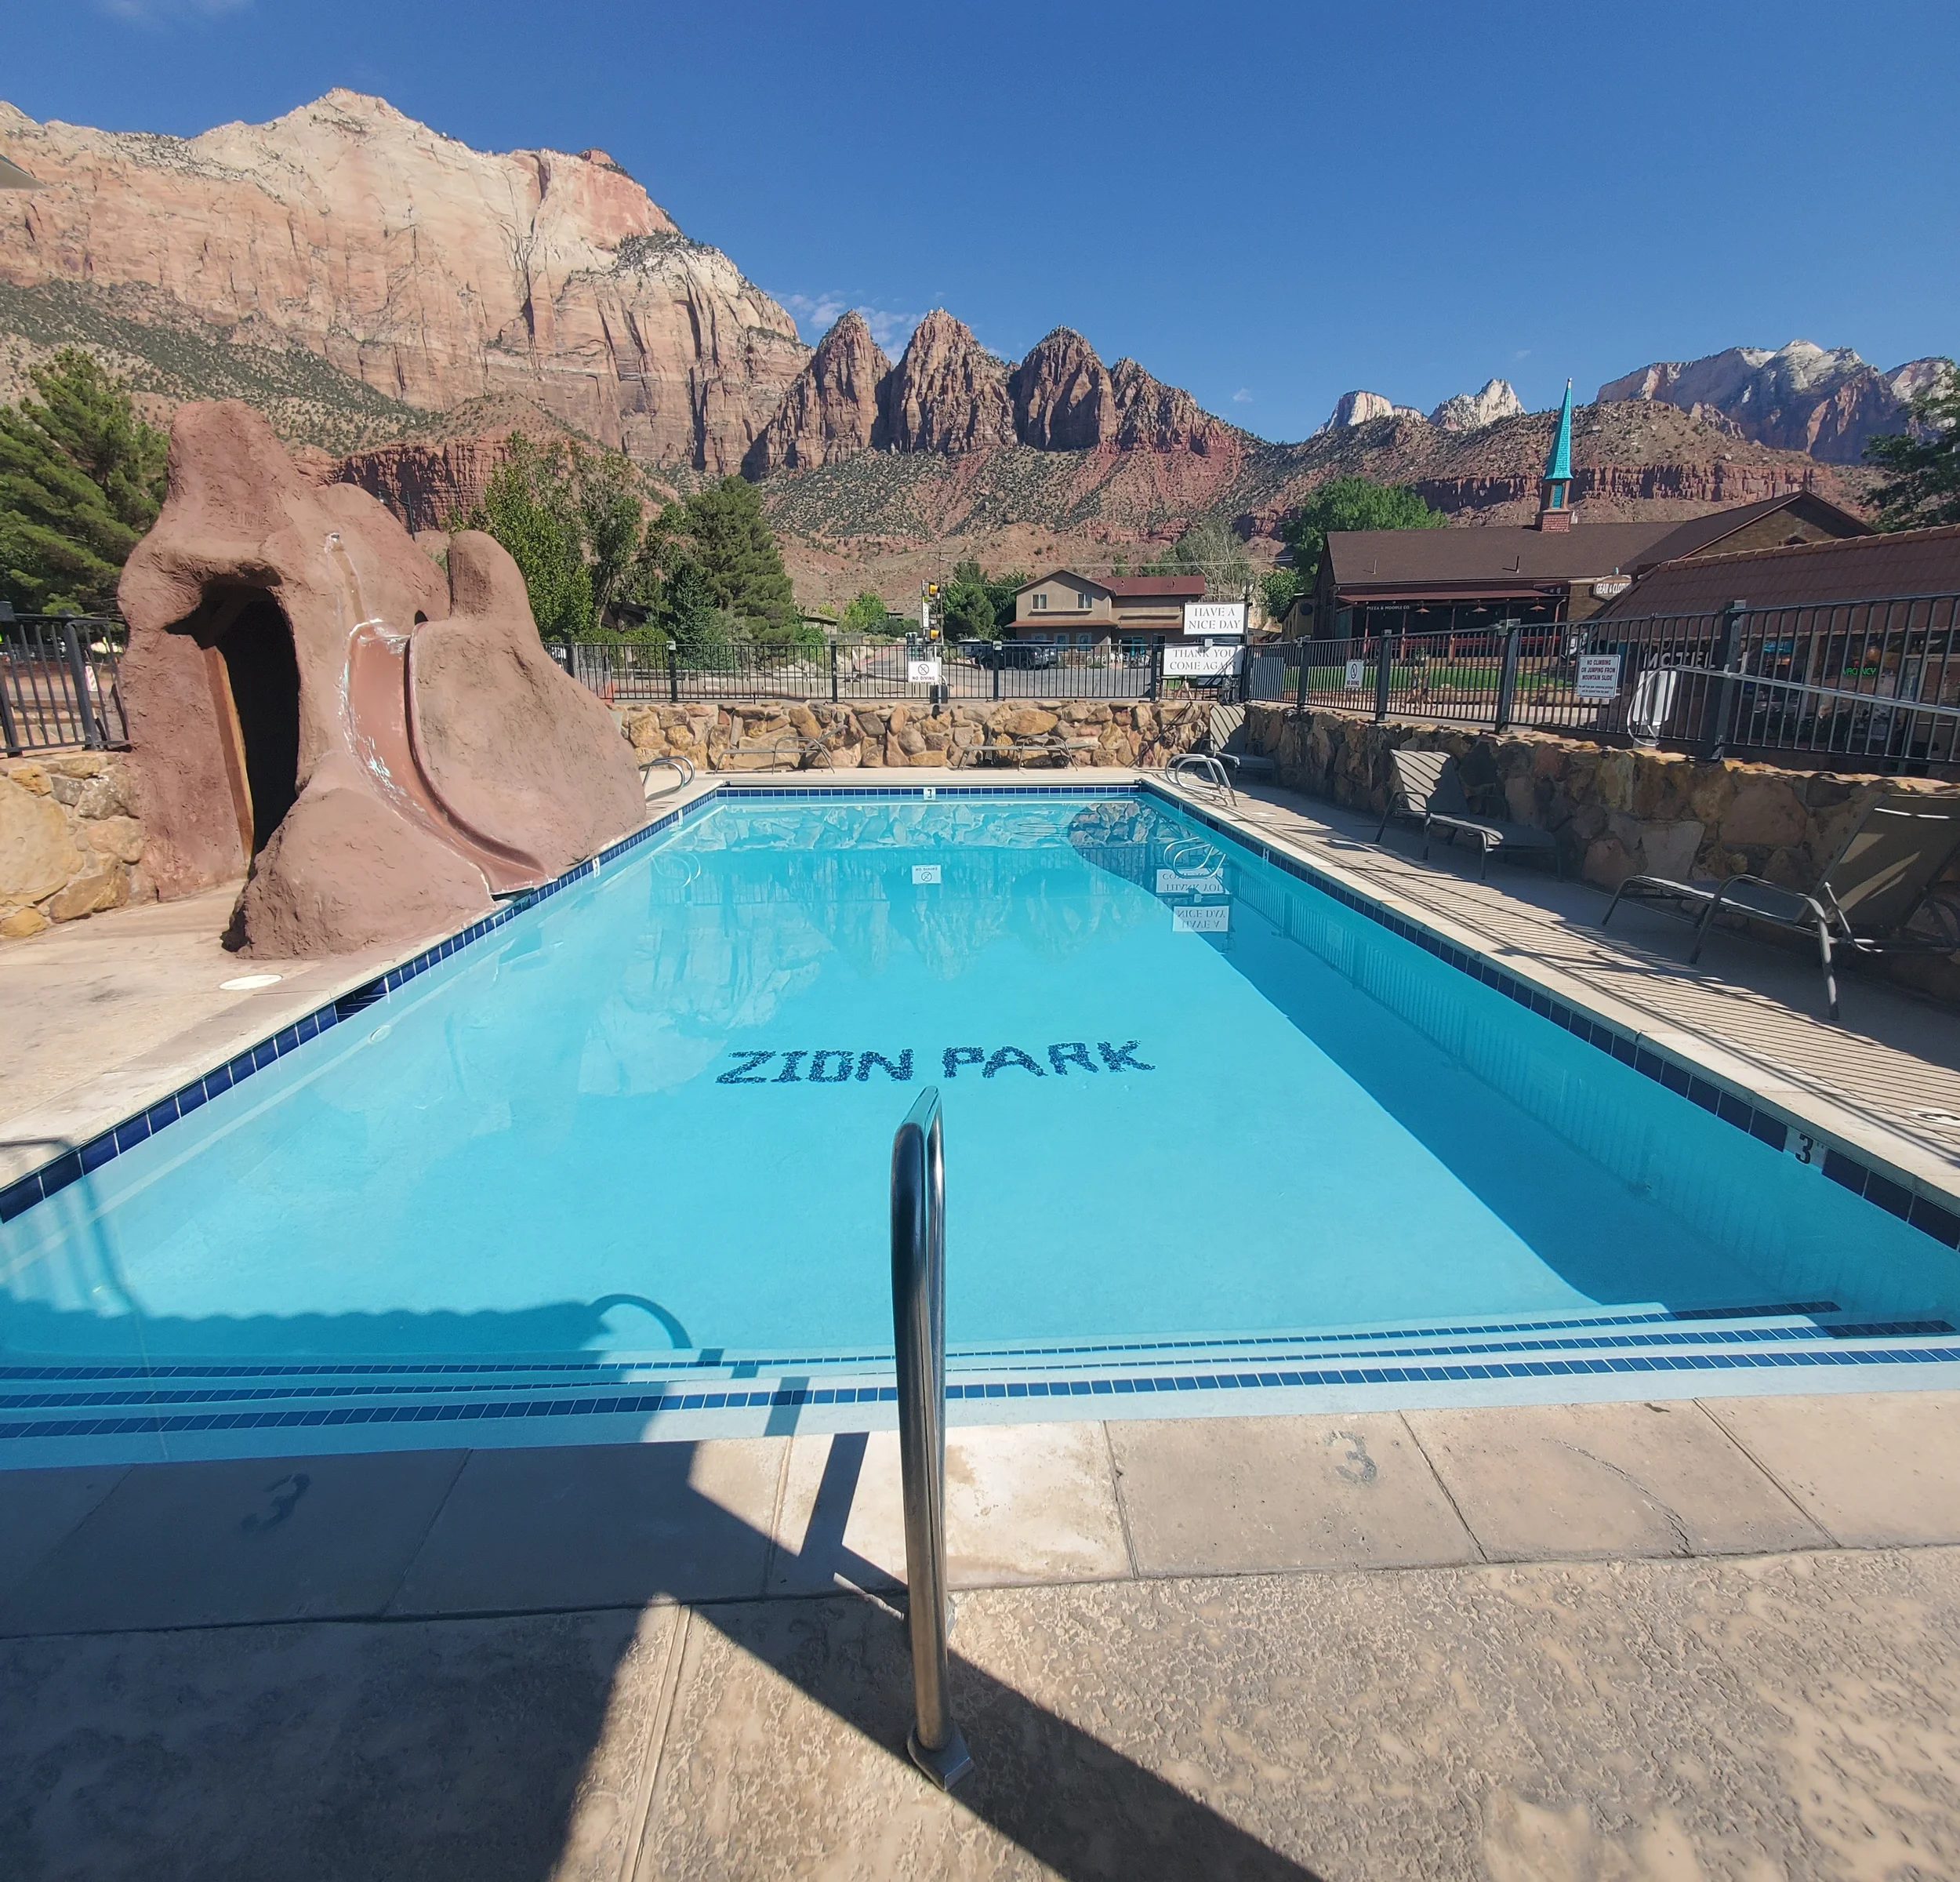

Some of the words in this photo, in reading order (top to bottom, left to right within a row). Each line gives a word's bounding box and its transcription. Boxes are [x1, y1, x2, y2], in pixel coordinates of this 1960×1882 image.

[1596, 583, 1610, 594] GEAR
[1194, 607, 1225, 616] HAVE
[1228, 607, 1235, 616] A
[1189, 620, 1215, 629] NICE
[1220, 620, 1241, 629] DAY
[1214, 649, 1234, 657] YOU
[1203, 662, 1236, 670] AGAIN
[927, 789, 932, 798] 3
[715, 1049, 913, 1084] ZION
[942, 1041, 1155, 1079] PARK
[1795, 1133, 1813, 1164] 3
[1323, 1430, 1377, 1486] 3
[240, 1473, 310, 1534] 3
